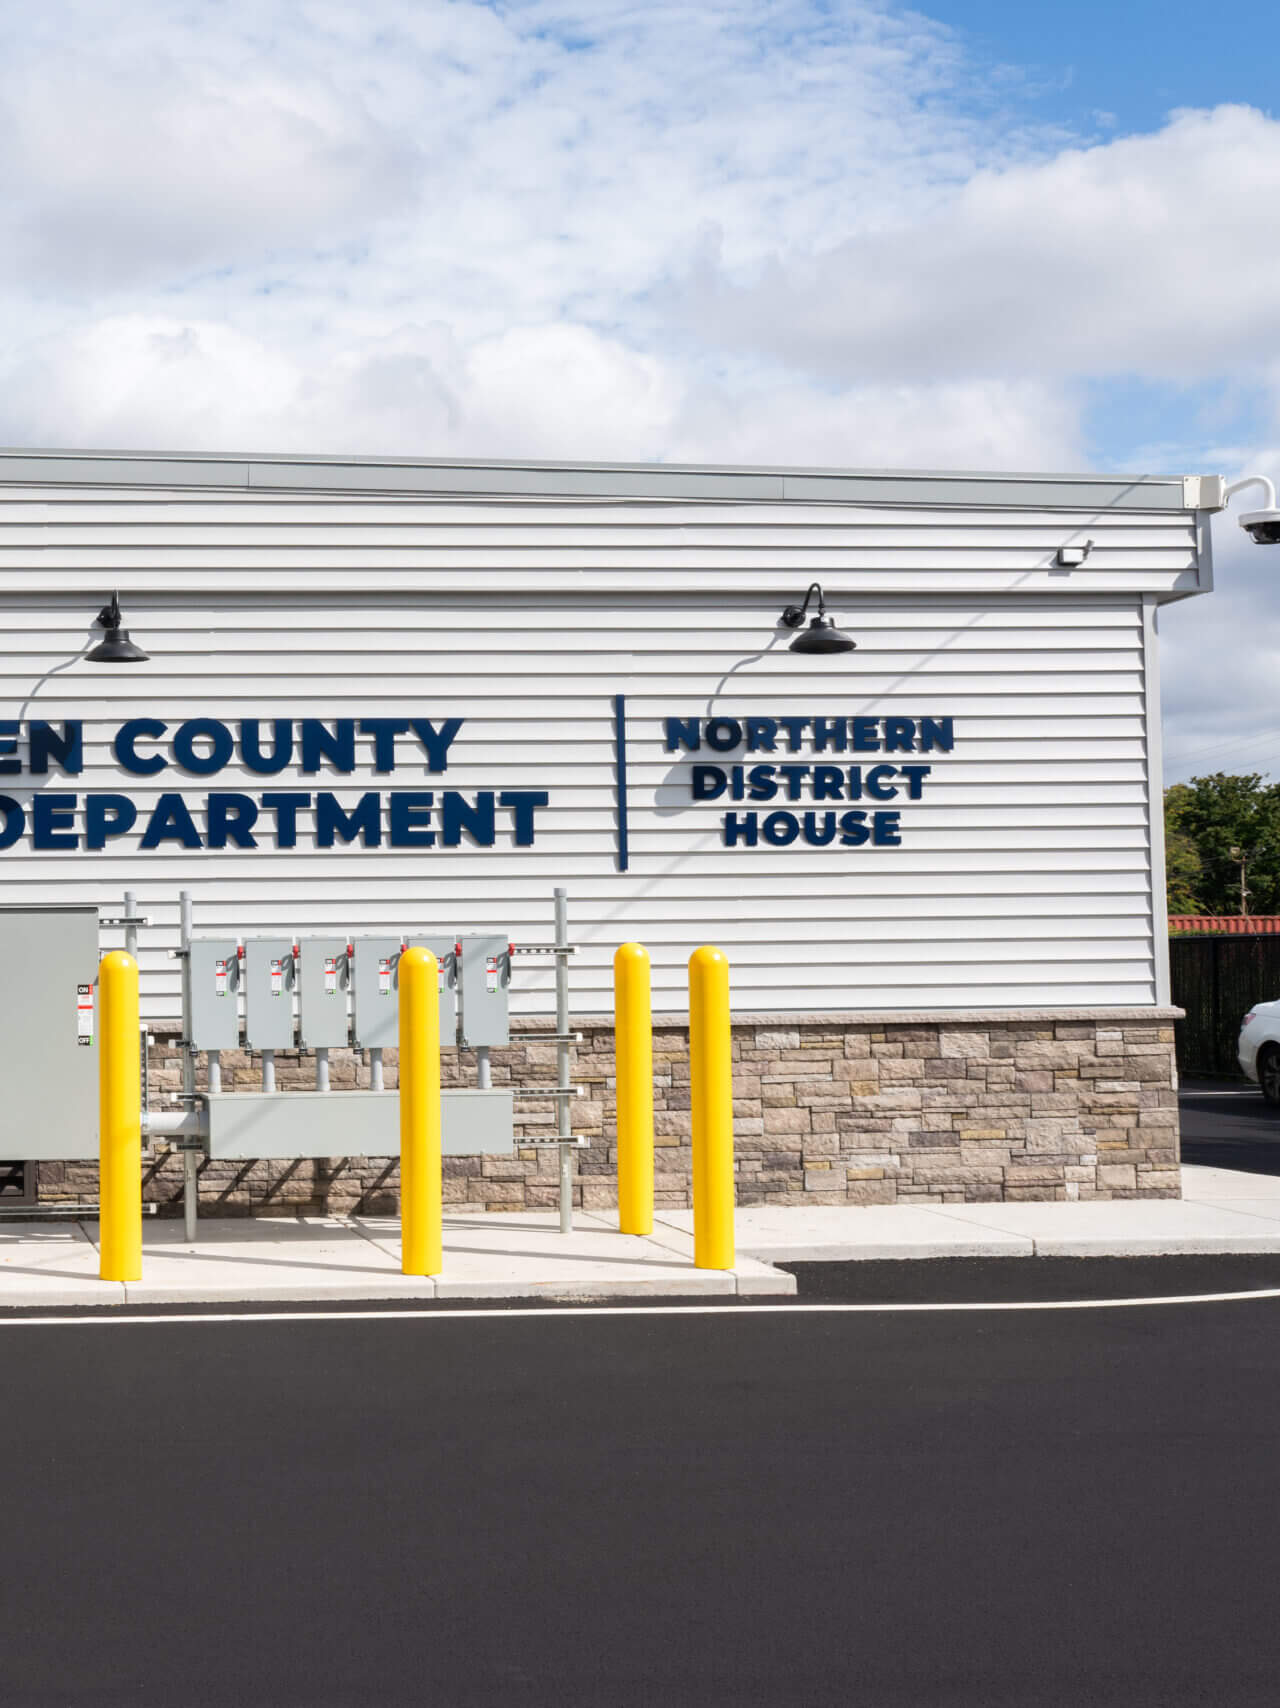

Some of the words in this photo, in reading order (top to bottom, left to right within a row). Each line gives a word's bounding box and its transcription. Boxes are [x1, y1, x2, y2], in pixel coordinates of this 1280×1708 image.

[112, 718, 466, 774] COUNTY
[666, 716, 955, 752] NORTHERN
[691, 765, 932, 801] DISTRICT
[723, 810, 903, 847] HOUSE
